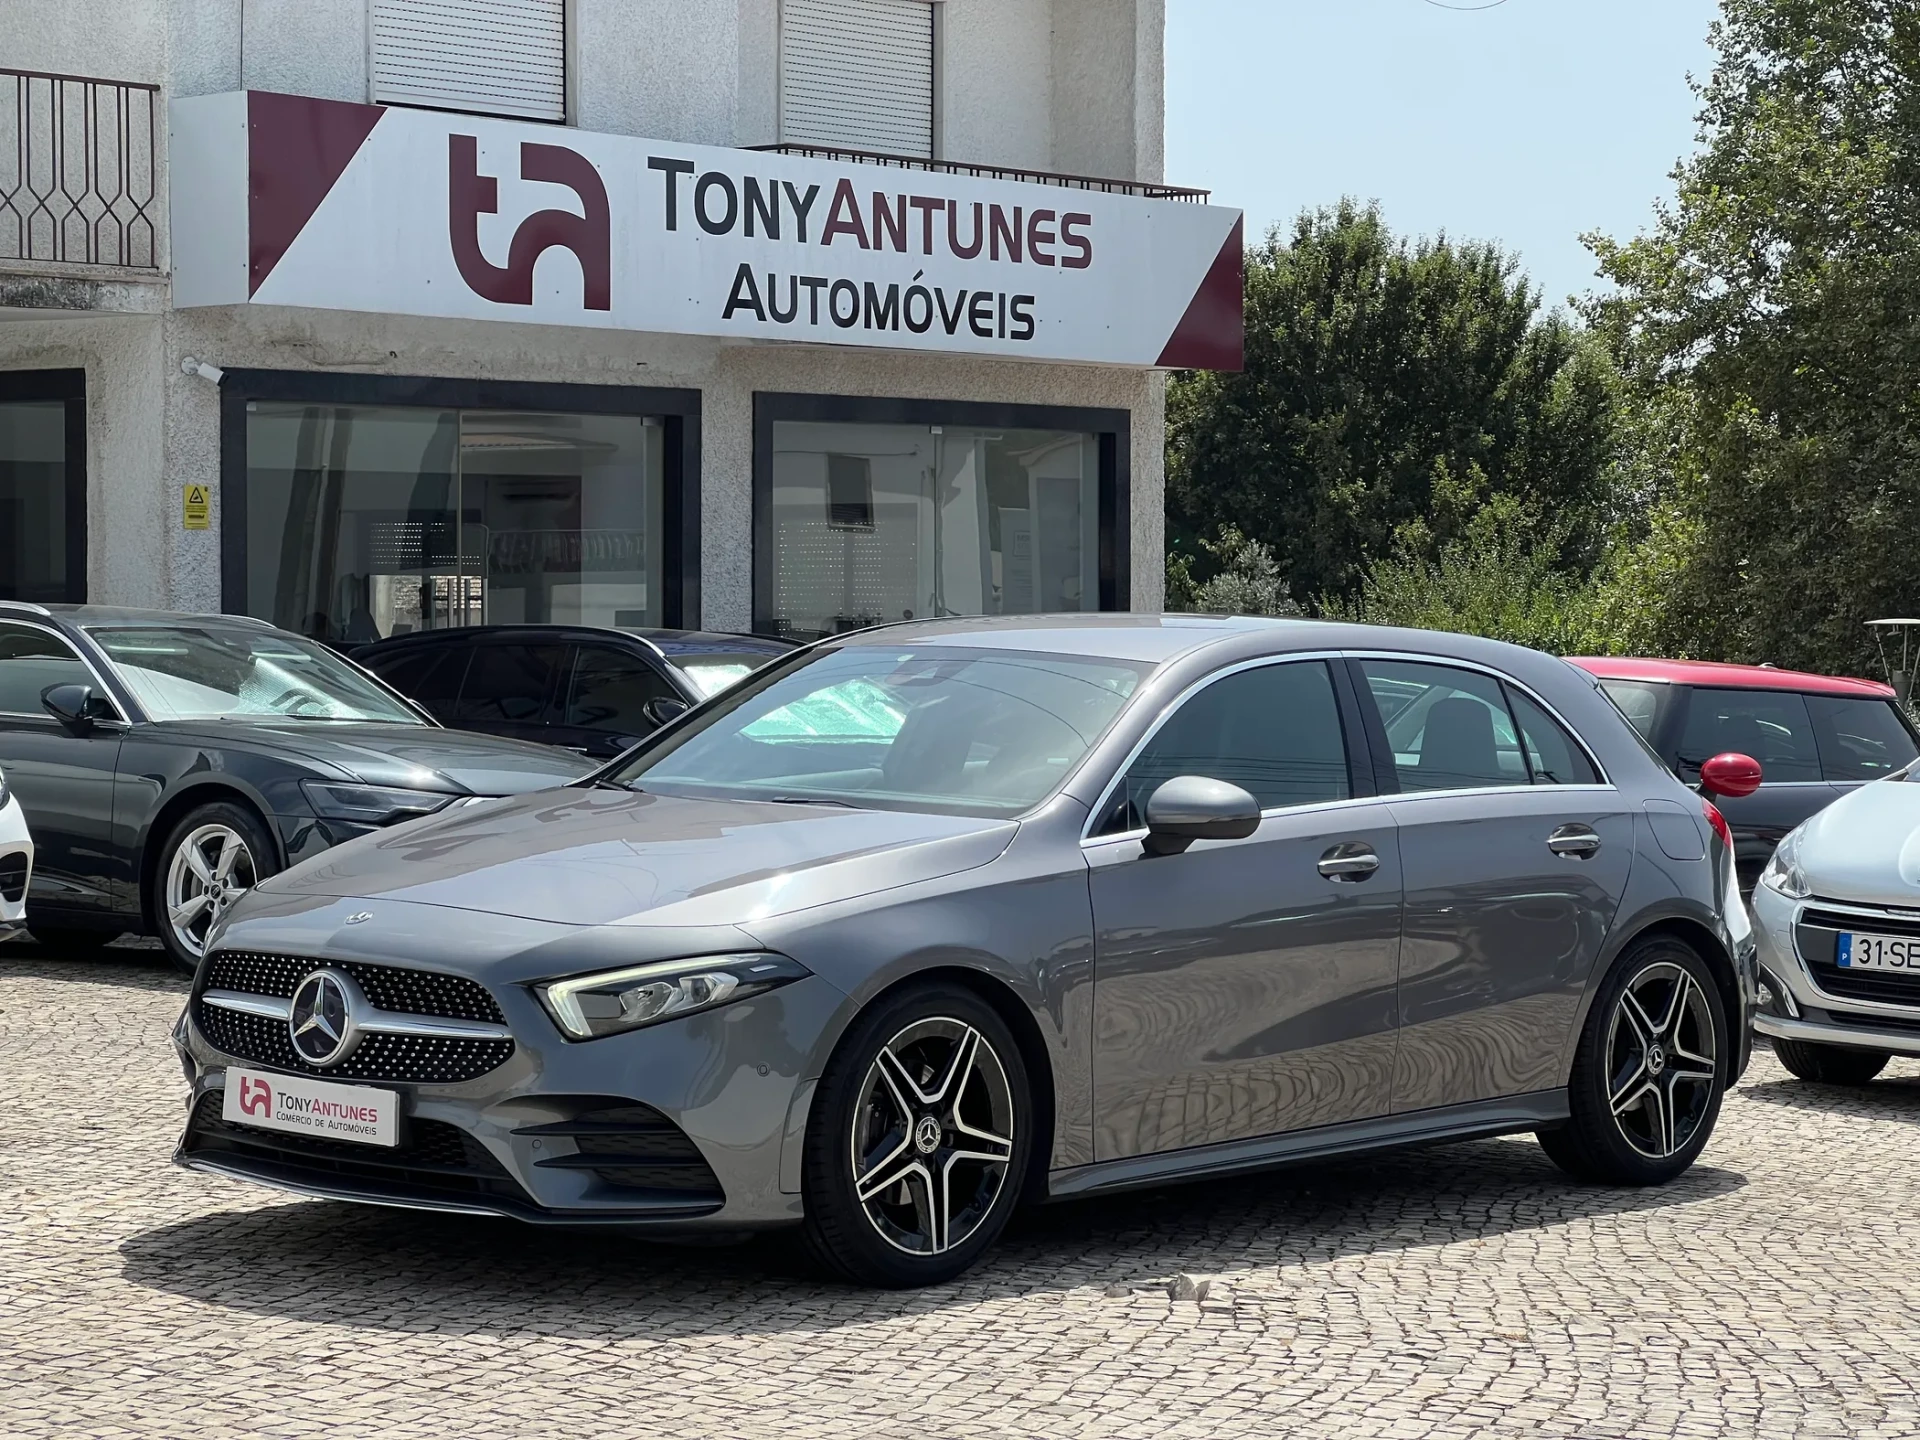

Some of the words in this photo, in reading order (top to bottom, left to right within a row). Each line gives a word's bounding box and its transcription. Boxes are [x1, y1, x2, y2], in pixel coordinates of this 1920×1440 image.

[722, 263, 1035, 341] AUTOMÓVEIS
[315, 1118, 325, 1128] DE
[328, 1120, 376, 1135] AUTOMÓVEIS
